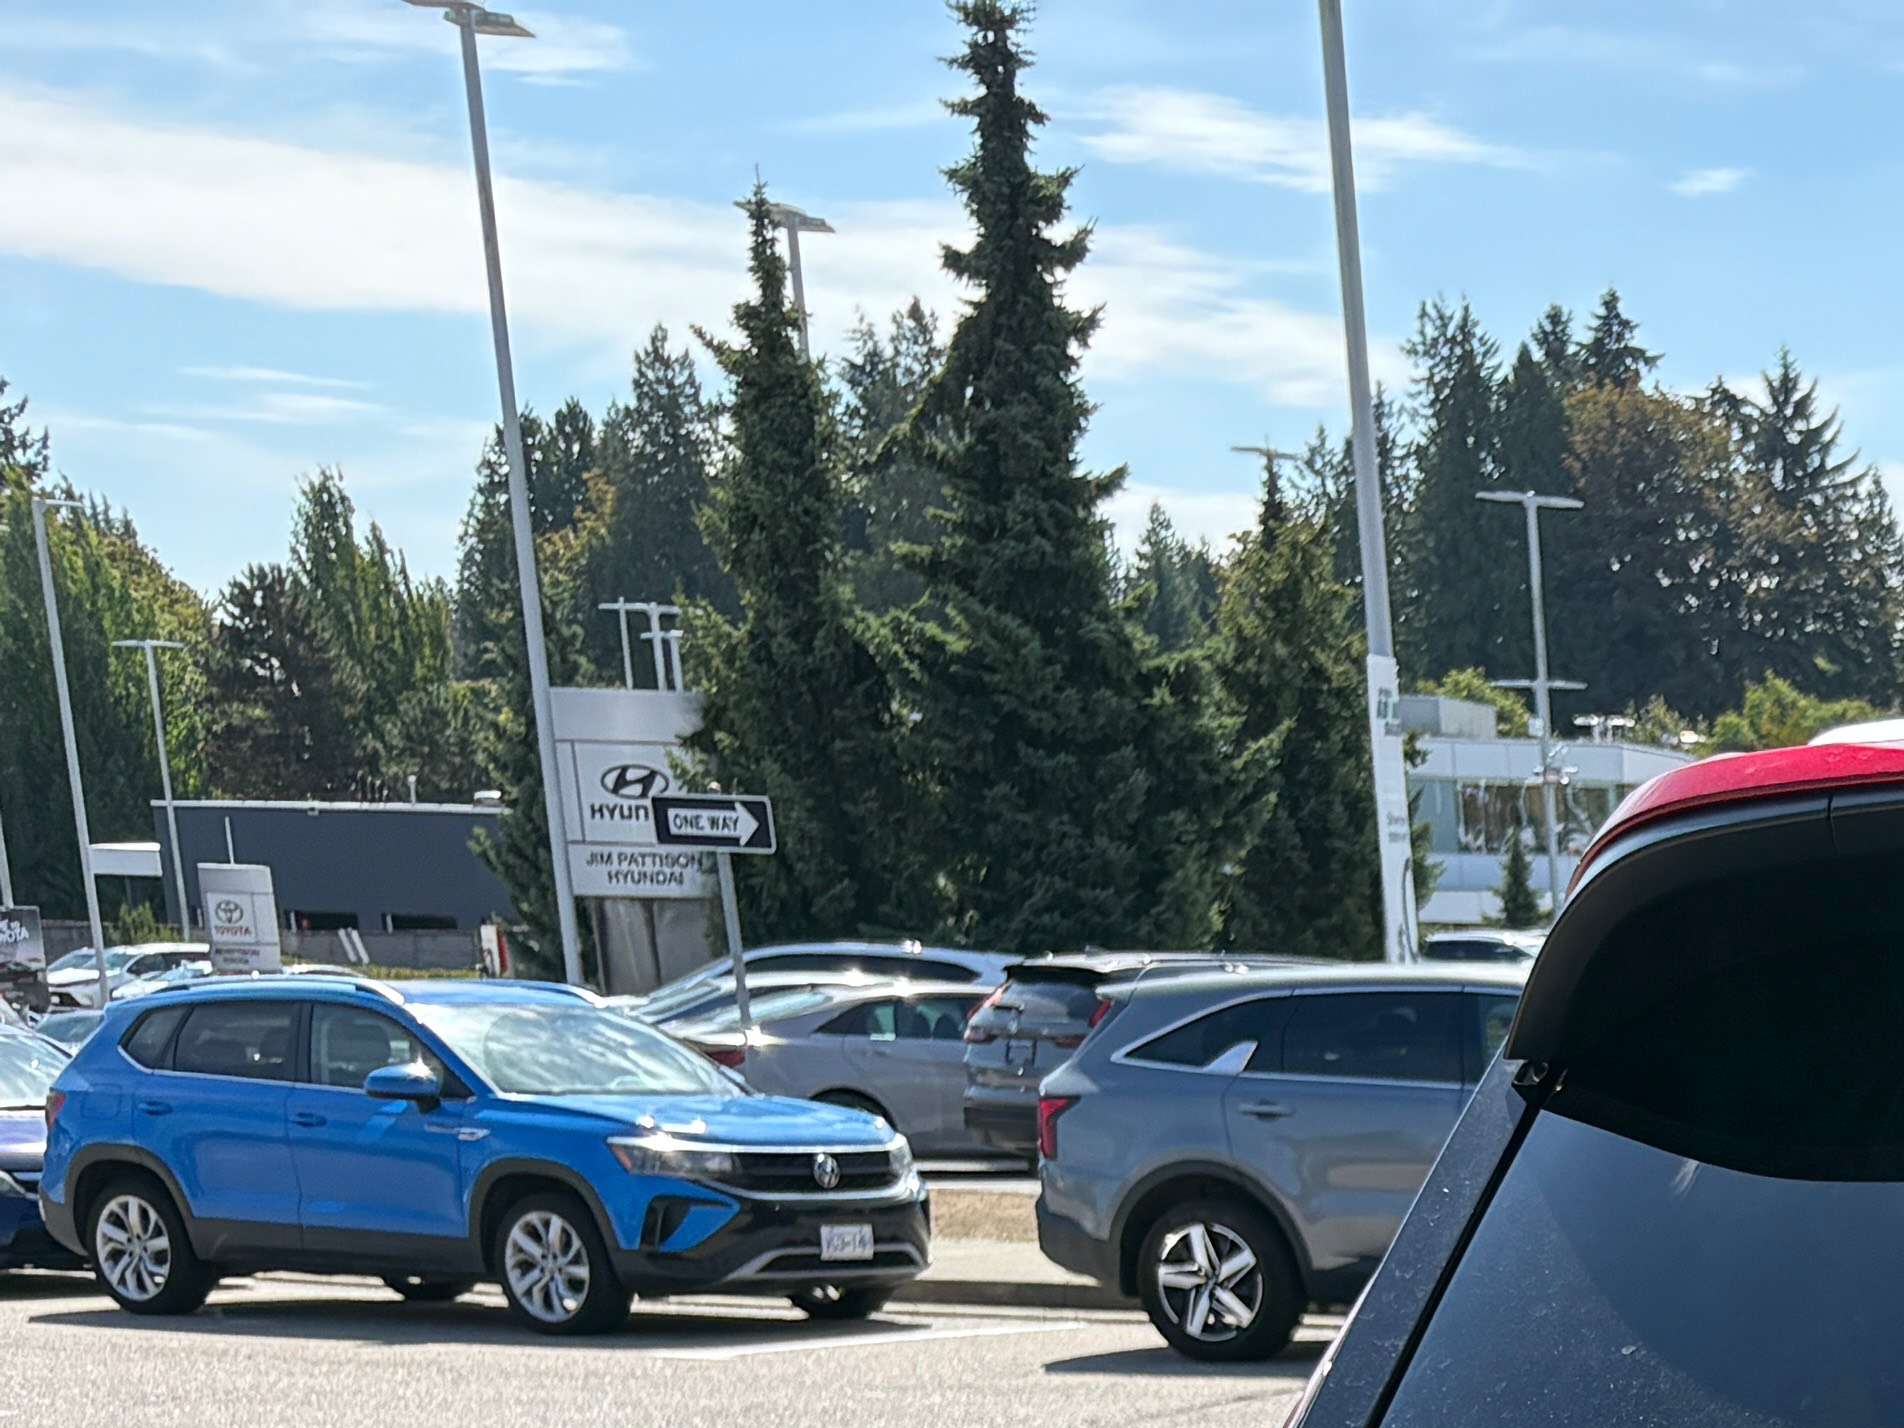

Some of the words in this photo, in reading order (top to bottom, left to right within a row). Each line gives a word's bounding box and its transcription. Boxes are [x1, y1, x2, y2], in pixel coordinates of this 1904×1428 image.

[590, 803, 650, 821] HYUN
[673, 813, 704, 830] ONE
[708, 815, 739, 832] WAY
[586, 852, 613, 867] JIM
[618, 852, 702, 869] PATTISON
[607, 869, 684, 886] HYUNDAI
